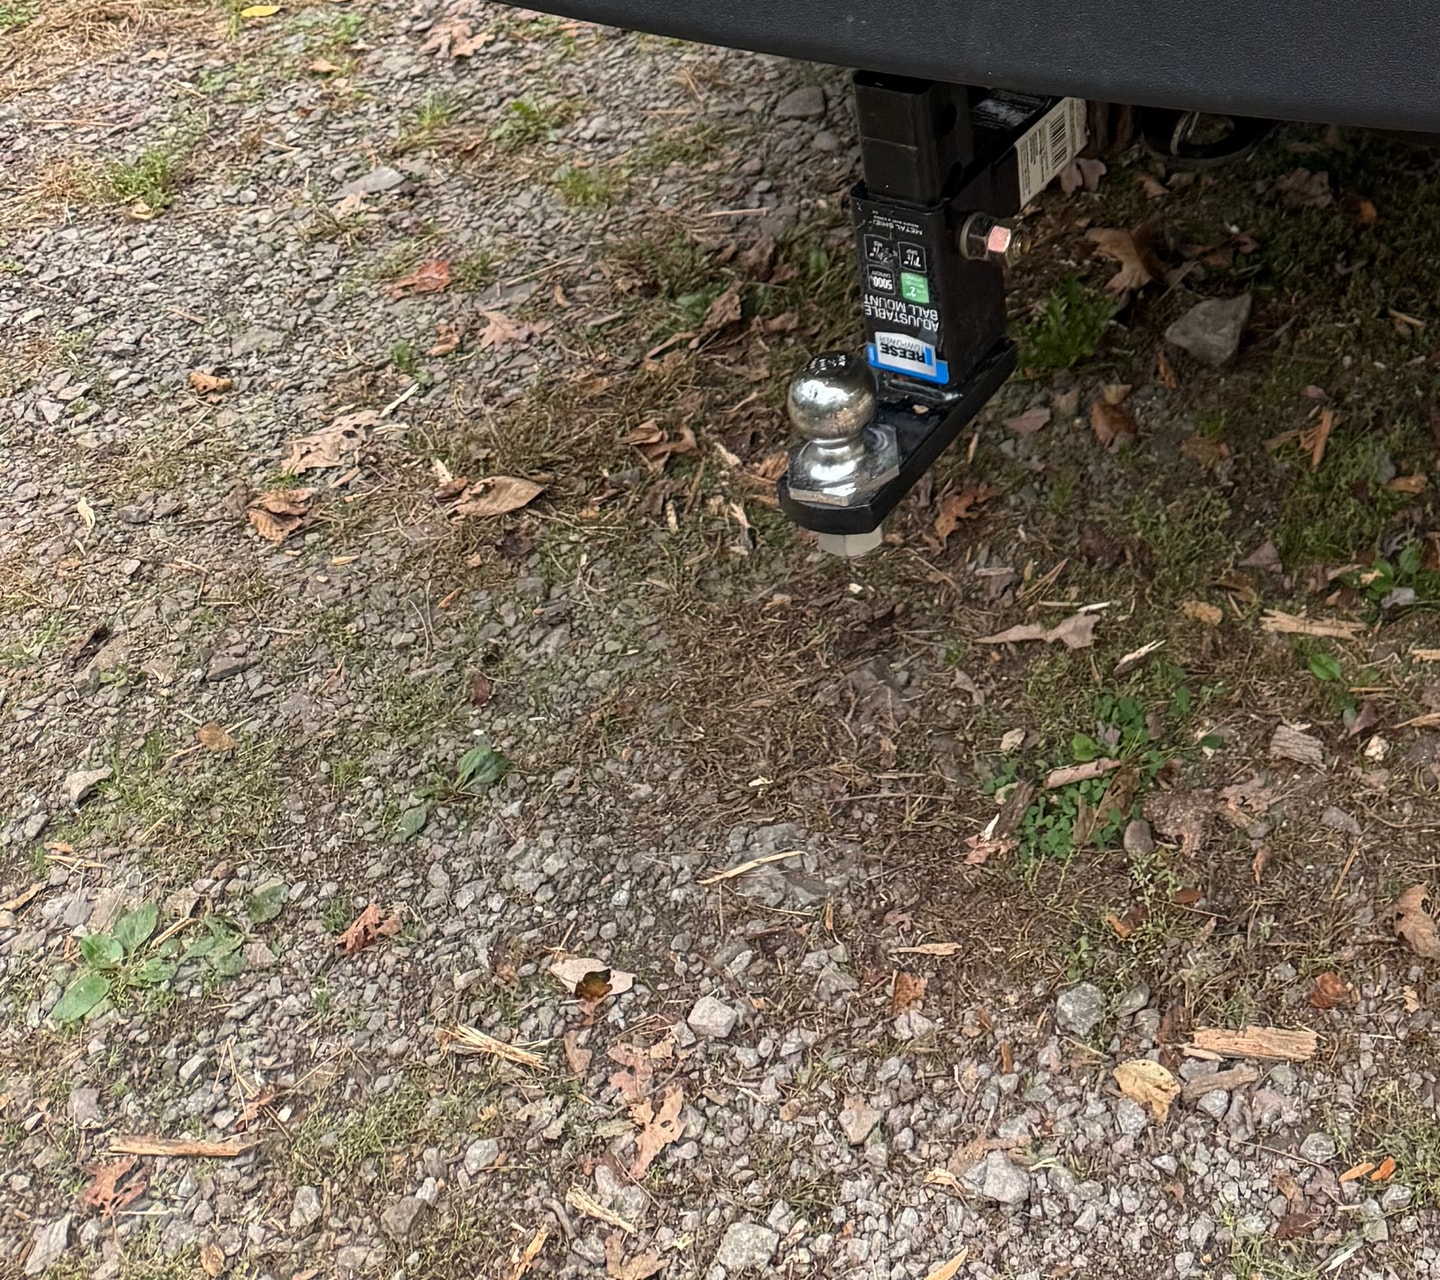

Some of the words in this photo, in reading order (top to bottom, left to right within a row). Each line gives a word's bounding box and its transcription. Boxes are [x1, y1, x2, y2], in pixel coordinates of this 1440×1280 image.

[863, 293, 906, 313] MOUNT
[908, 304, 938, 322] BALL
[864, 305, 940, 332] ADJUSTABLE
[880, 343, 926, 364] REESE
